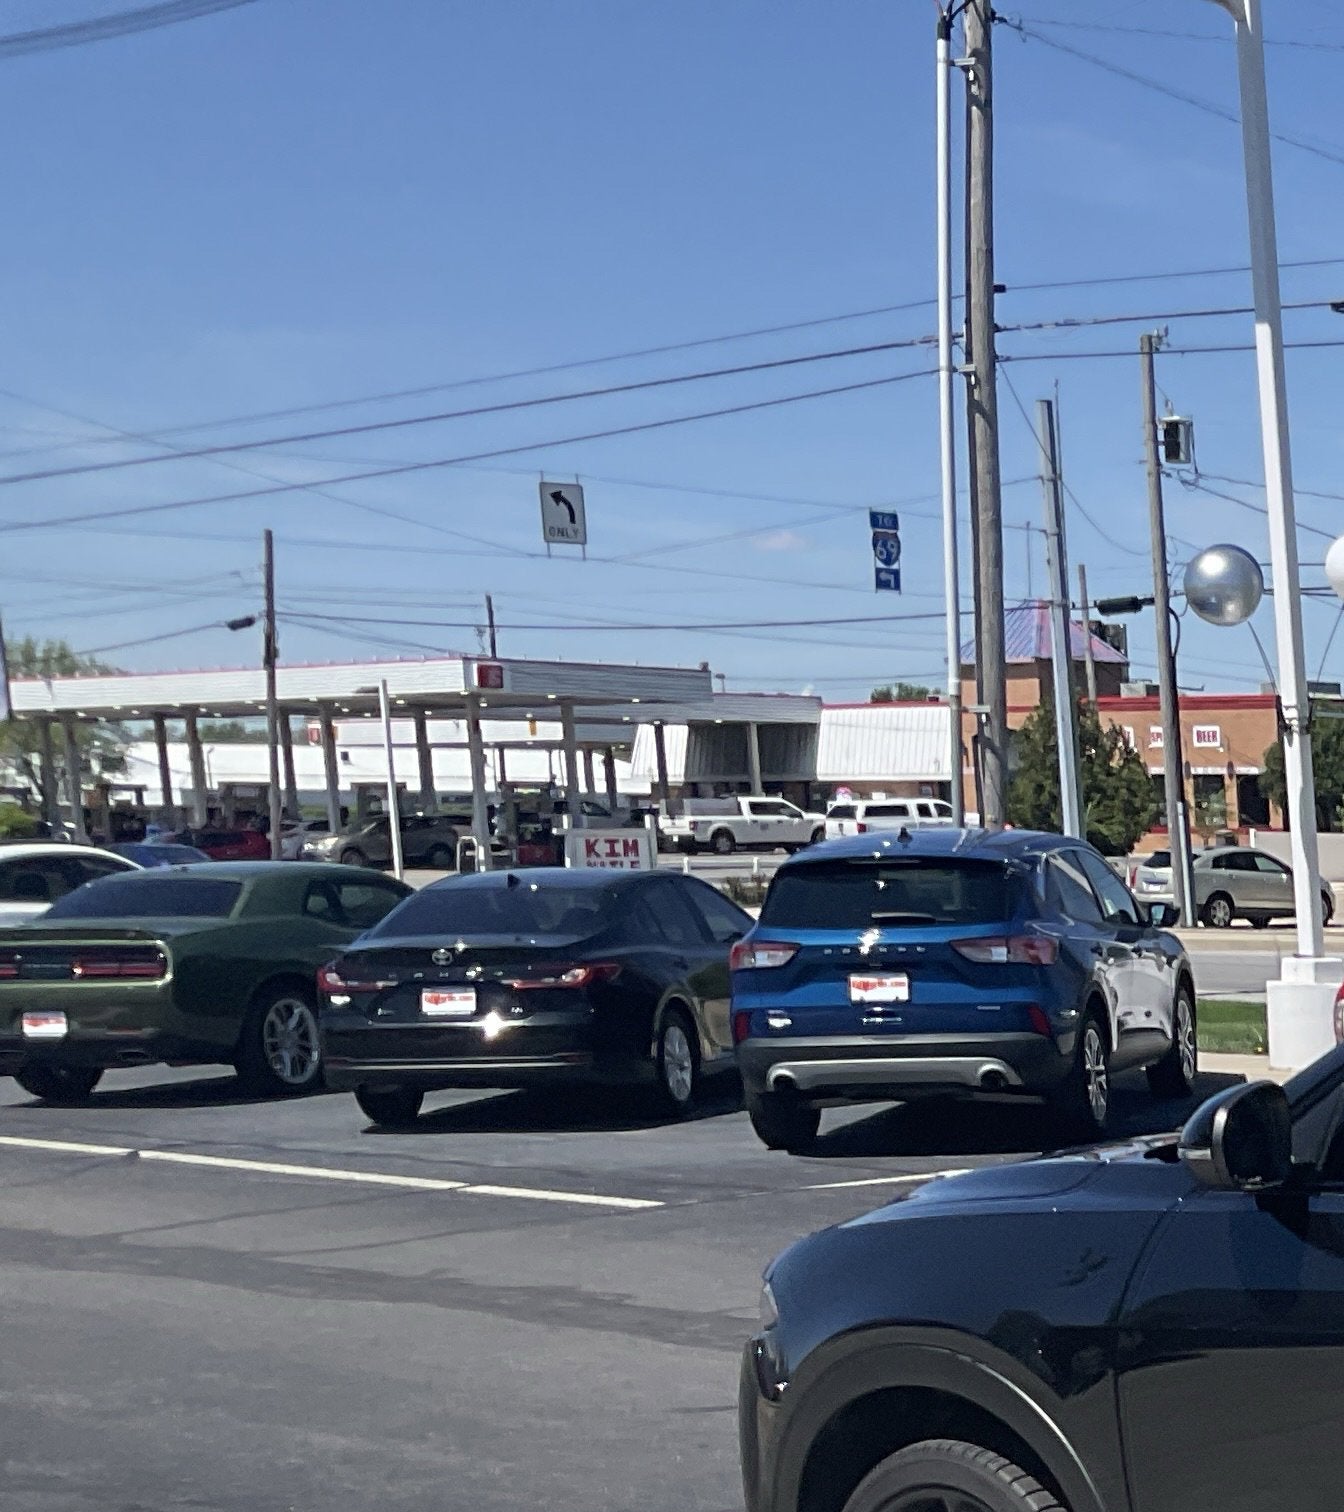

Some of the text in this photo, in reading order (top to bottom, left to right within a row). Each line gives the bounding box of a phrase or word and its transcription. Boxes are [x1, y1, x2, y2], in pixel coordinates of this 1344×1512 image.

[548, 526, 579, 539] ONLY
[876, 539, 898, 560] 69
[1196, 730, 1217, 743] BEER
[585, 838, 640, 858] KIM
